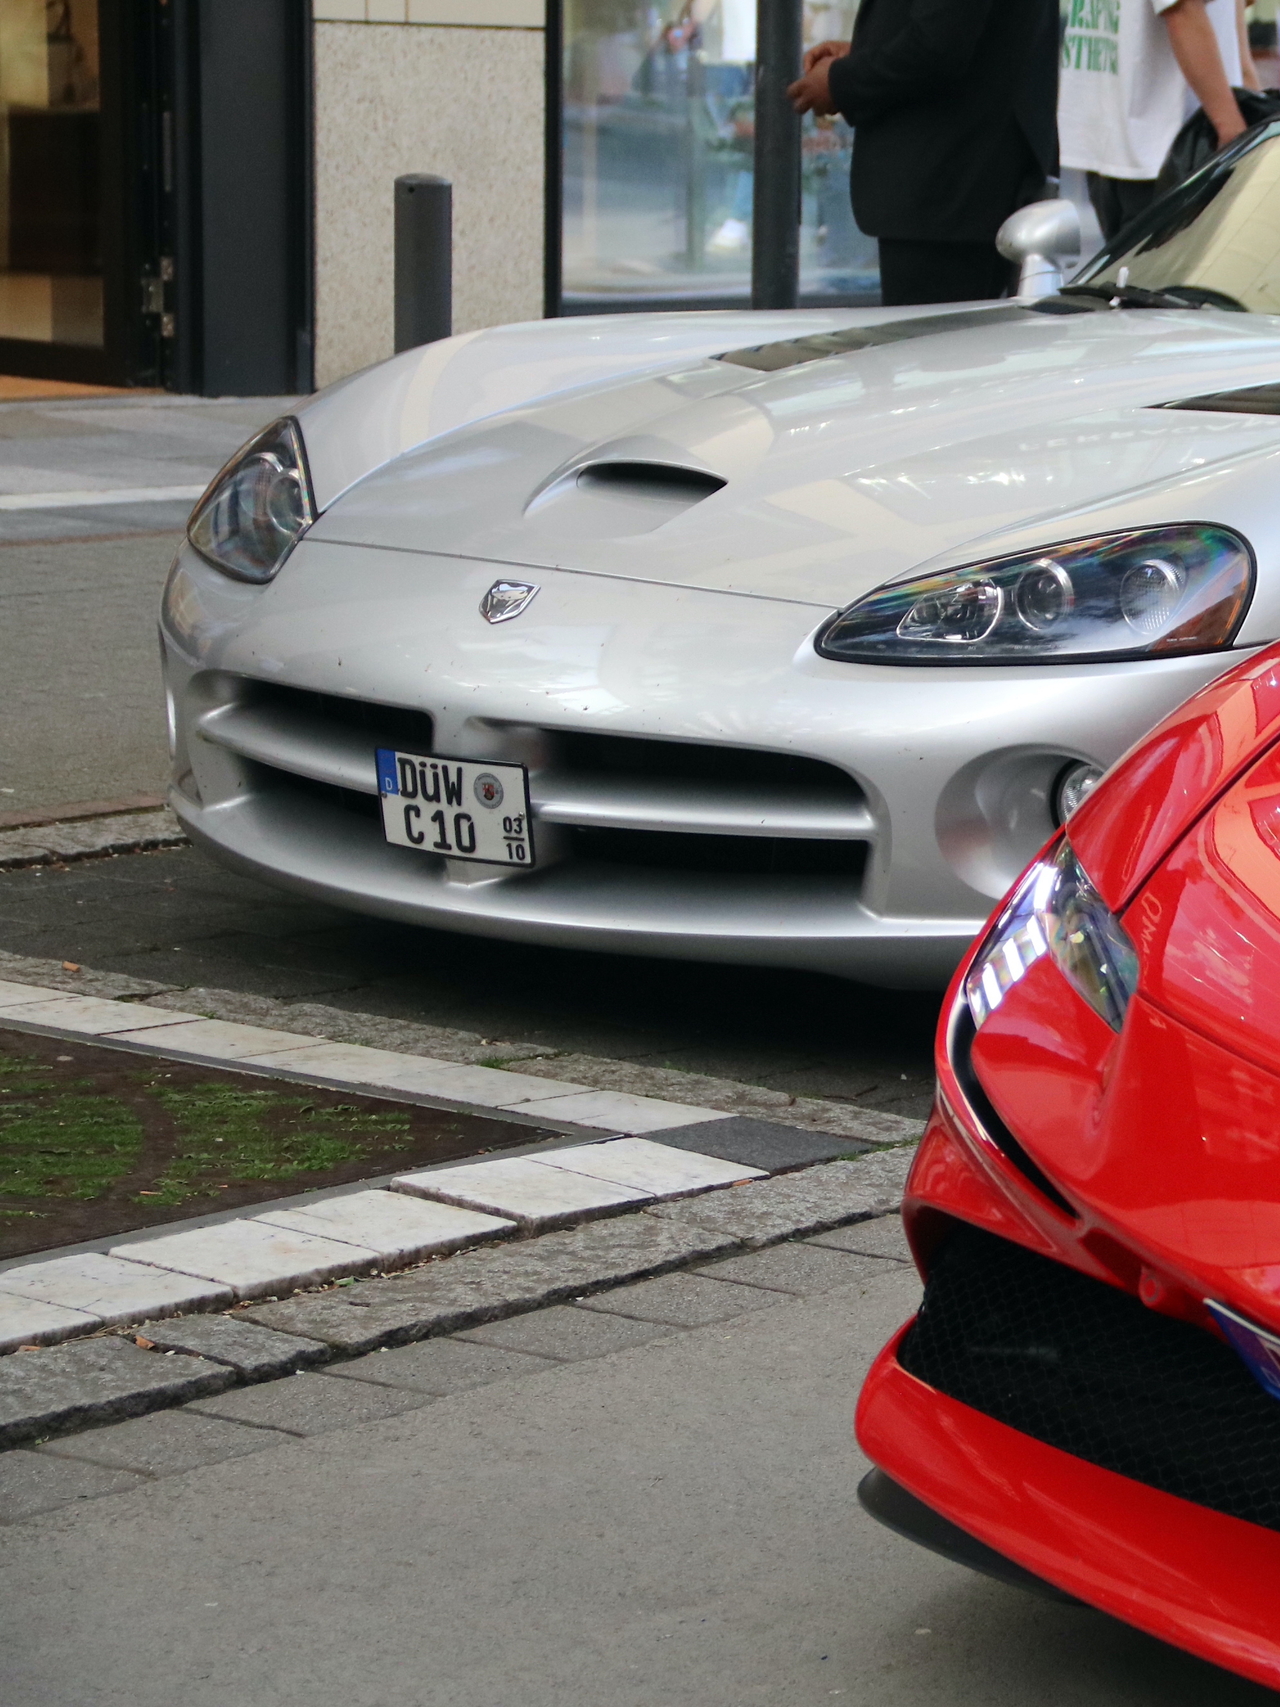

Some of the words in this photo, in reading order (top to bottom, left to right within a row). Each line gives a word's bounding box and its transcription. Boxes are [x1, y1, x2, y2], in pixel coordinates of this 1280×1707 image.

[385, 777, 393, 791] D
[397, 757, 463, 807] DÜW
[502, 816, 524, 834] 03
[505, 843, 526, 861] 10
